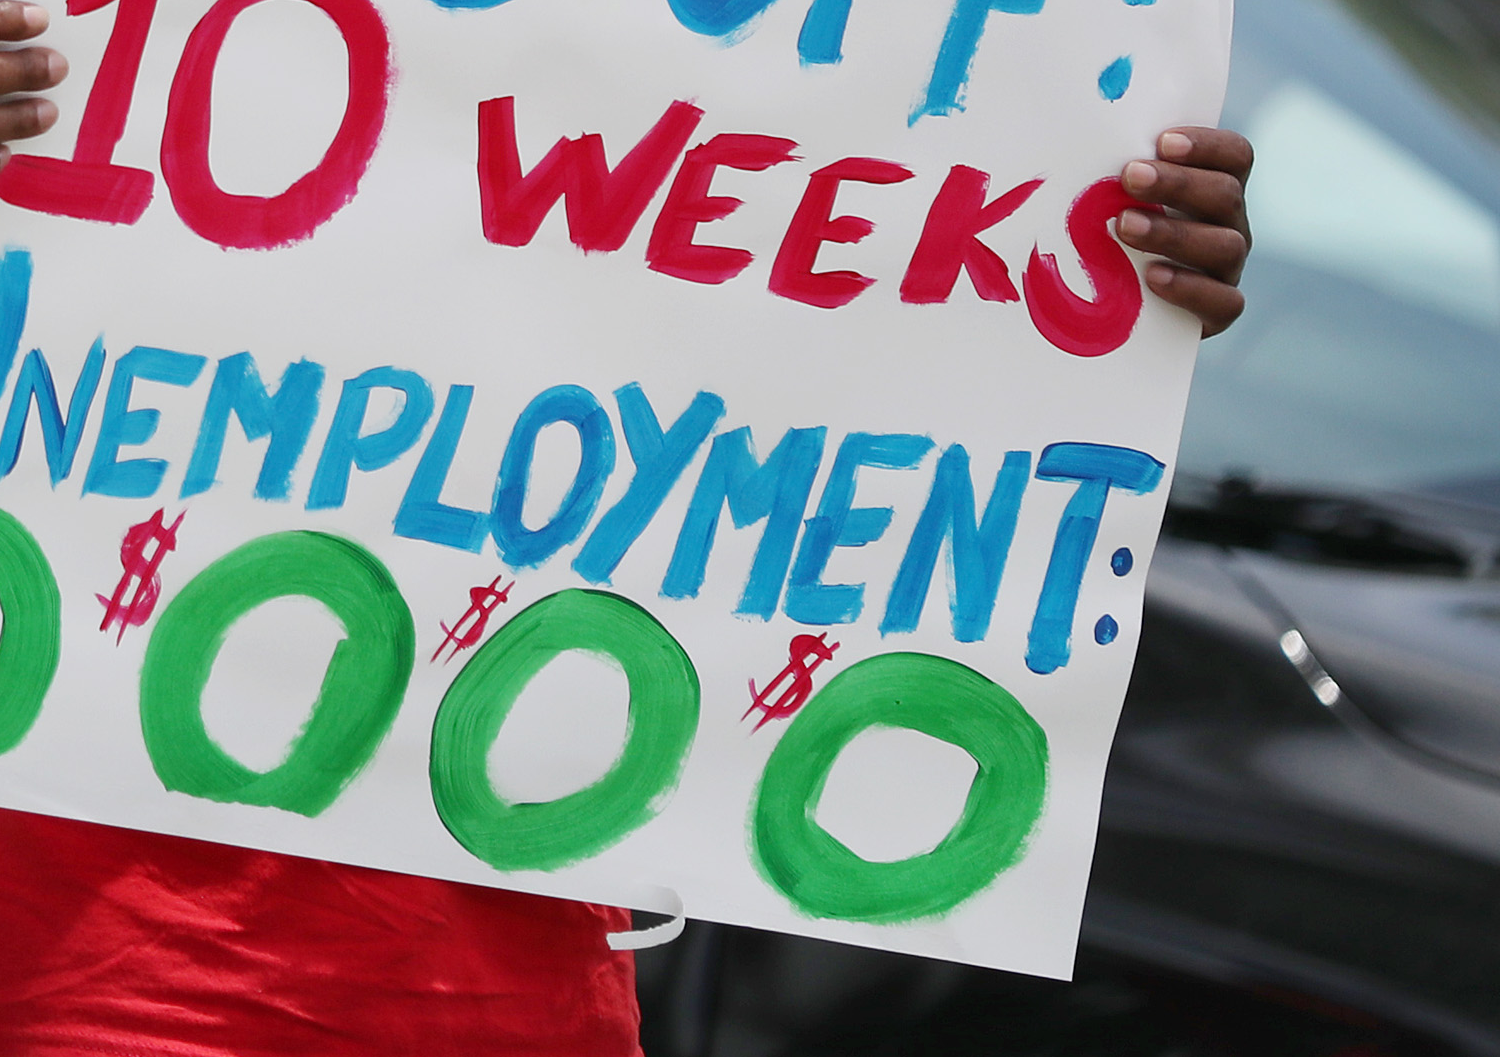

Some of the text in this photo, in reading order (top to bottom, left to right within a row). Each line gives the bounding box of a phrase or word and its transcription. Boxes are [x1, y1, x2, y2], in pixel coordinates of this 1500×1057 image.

[476, 96, 1167, 358] WEEKS
[94, 506, 416, 818] $0
[430, 574, 702, 873] $0
[741, 631, 1049, 925] $0
